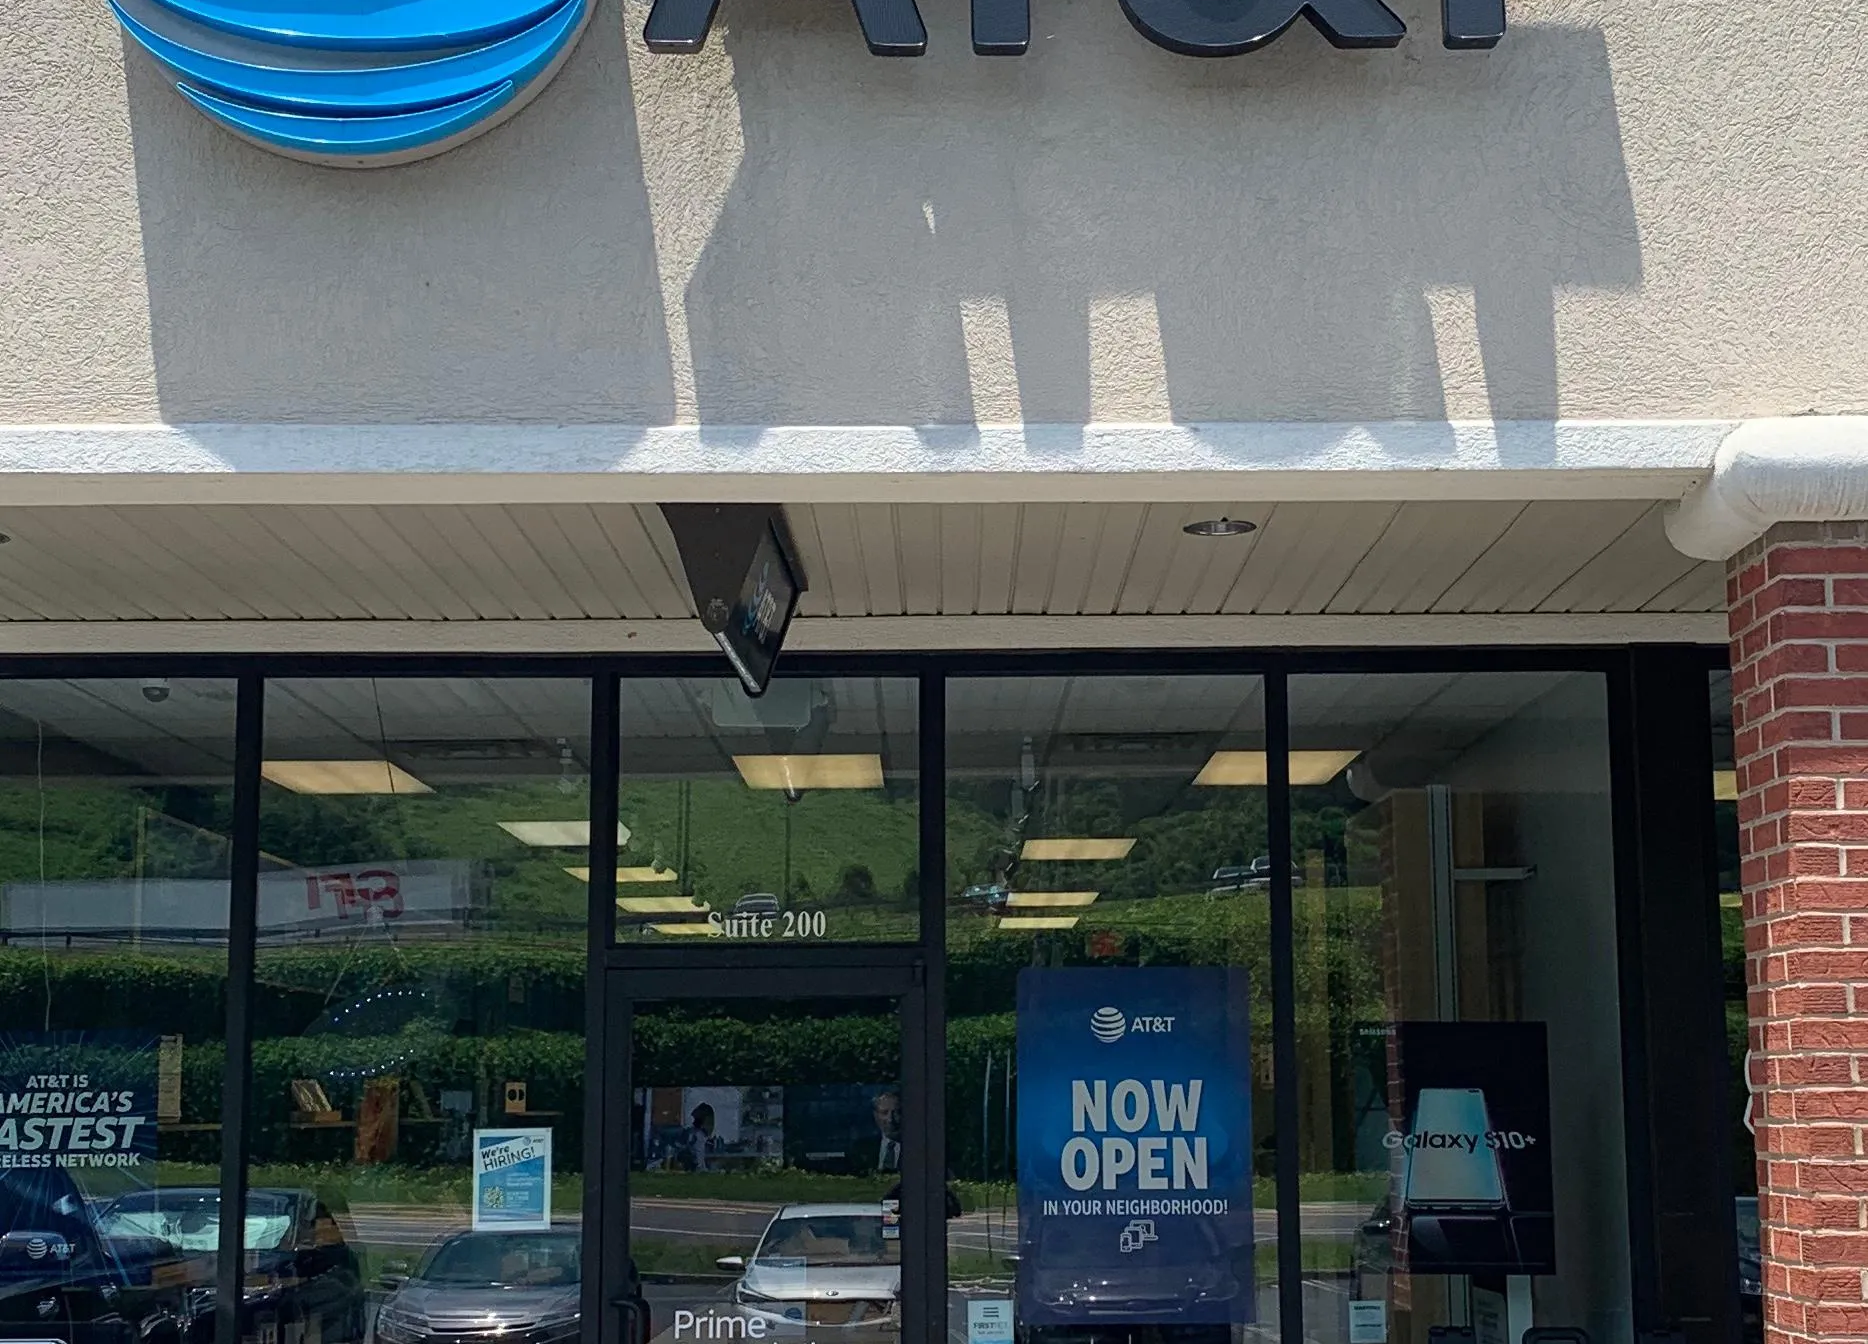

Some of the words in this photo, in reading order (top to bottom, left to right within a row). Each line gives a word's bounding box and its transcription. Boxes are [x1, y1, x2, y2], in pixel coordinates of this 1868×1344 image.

[708, 911, 773, 937] Suite
[783, 911, 826, 937] 200
[1131, 1016, 1175, 1032] AT&T
[26, 1075, 69, 1088] AT&T
[73, 1075, 89, 1087] IS
[1072, 1079, 1203, 1133] NOW
[1382, 1130, 1478, 1154] Galaxy
[0, 1154, 51, 1168] ELESS
[55, 1153, 141, 1167] NETWORK
[481, 1146, 510, 1159] We're
[483, 1146, 536, 1171] HIRING!
[1061, 1137, 1208, 1191] OPEN
[1043, 1200, 1058, 1216] IN
[1061, 1200, 1102, 1216] YOUR
[1106, 1199, 1228, 1215] NEIGHBORHOOD!
[50, 1243, 75, 1253] AT&T
[674, 1309, 766, 1339] Prime
